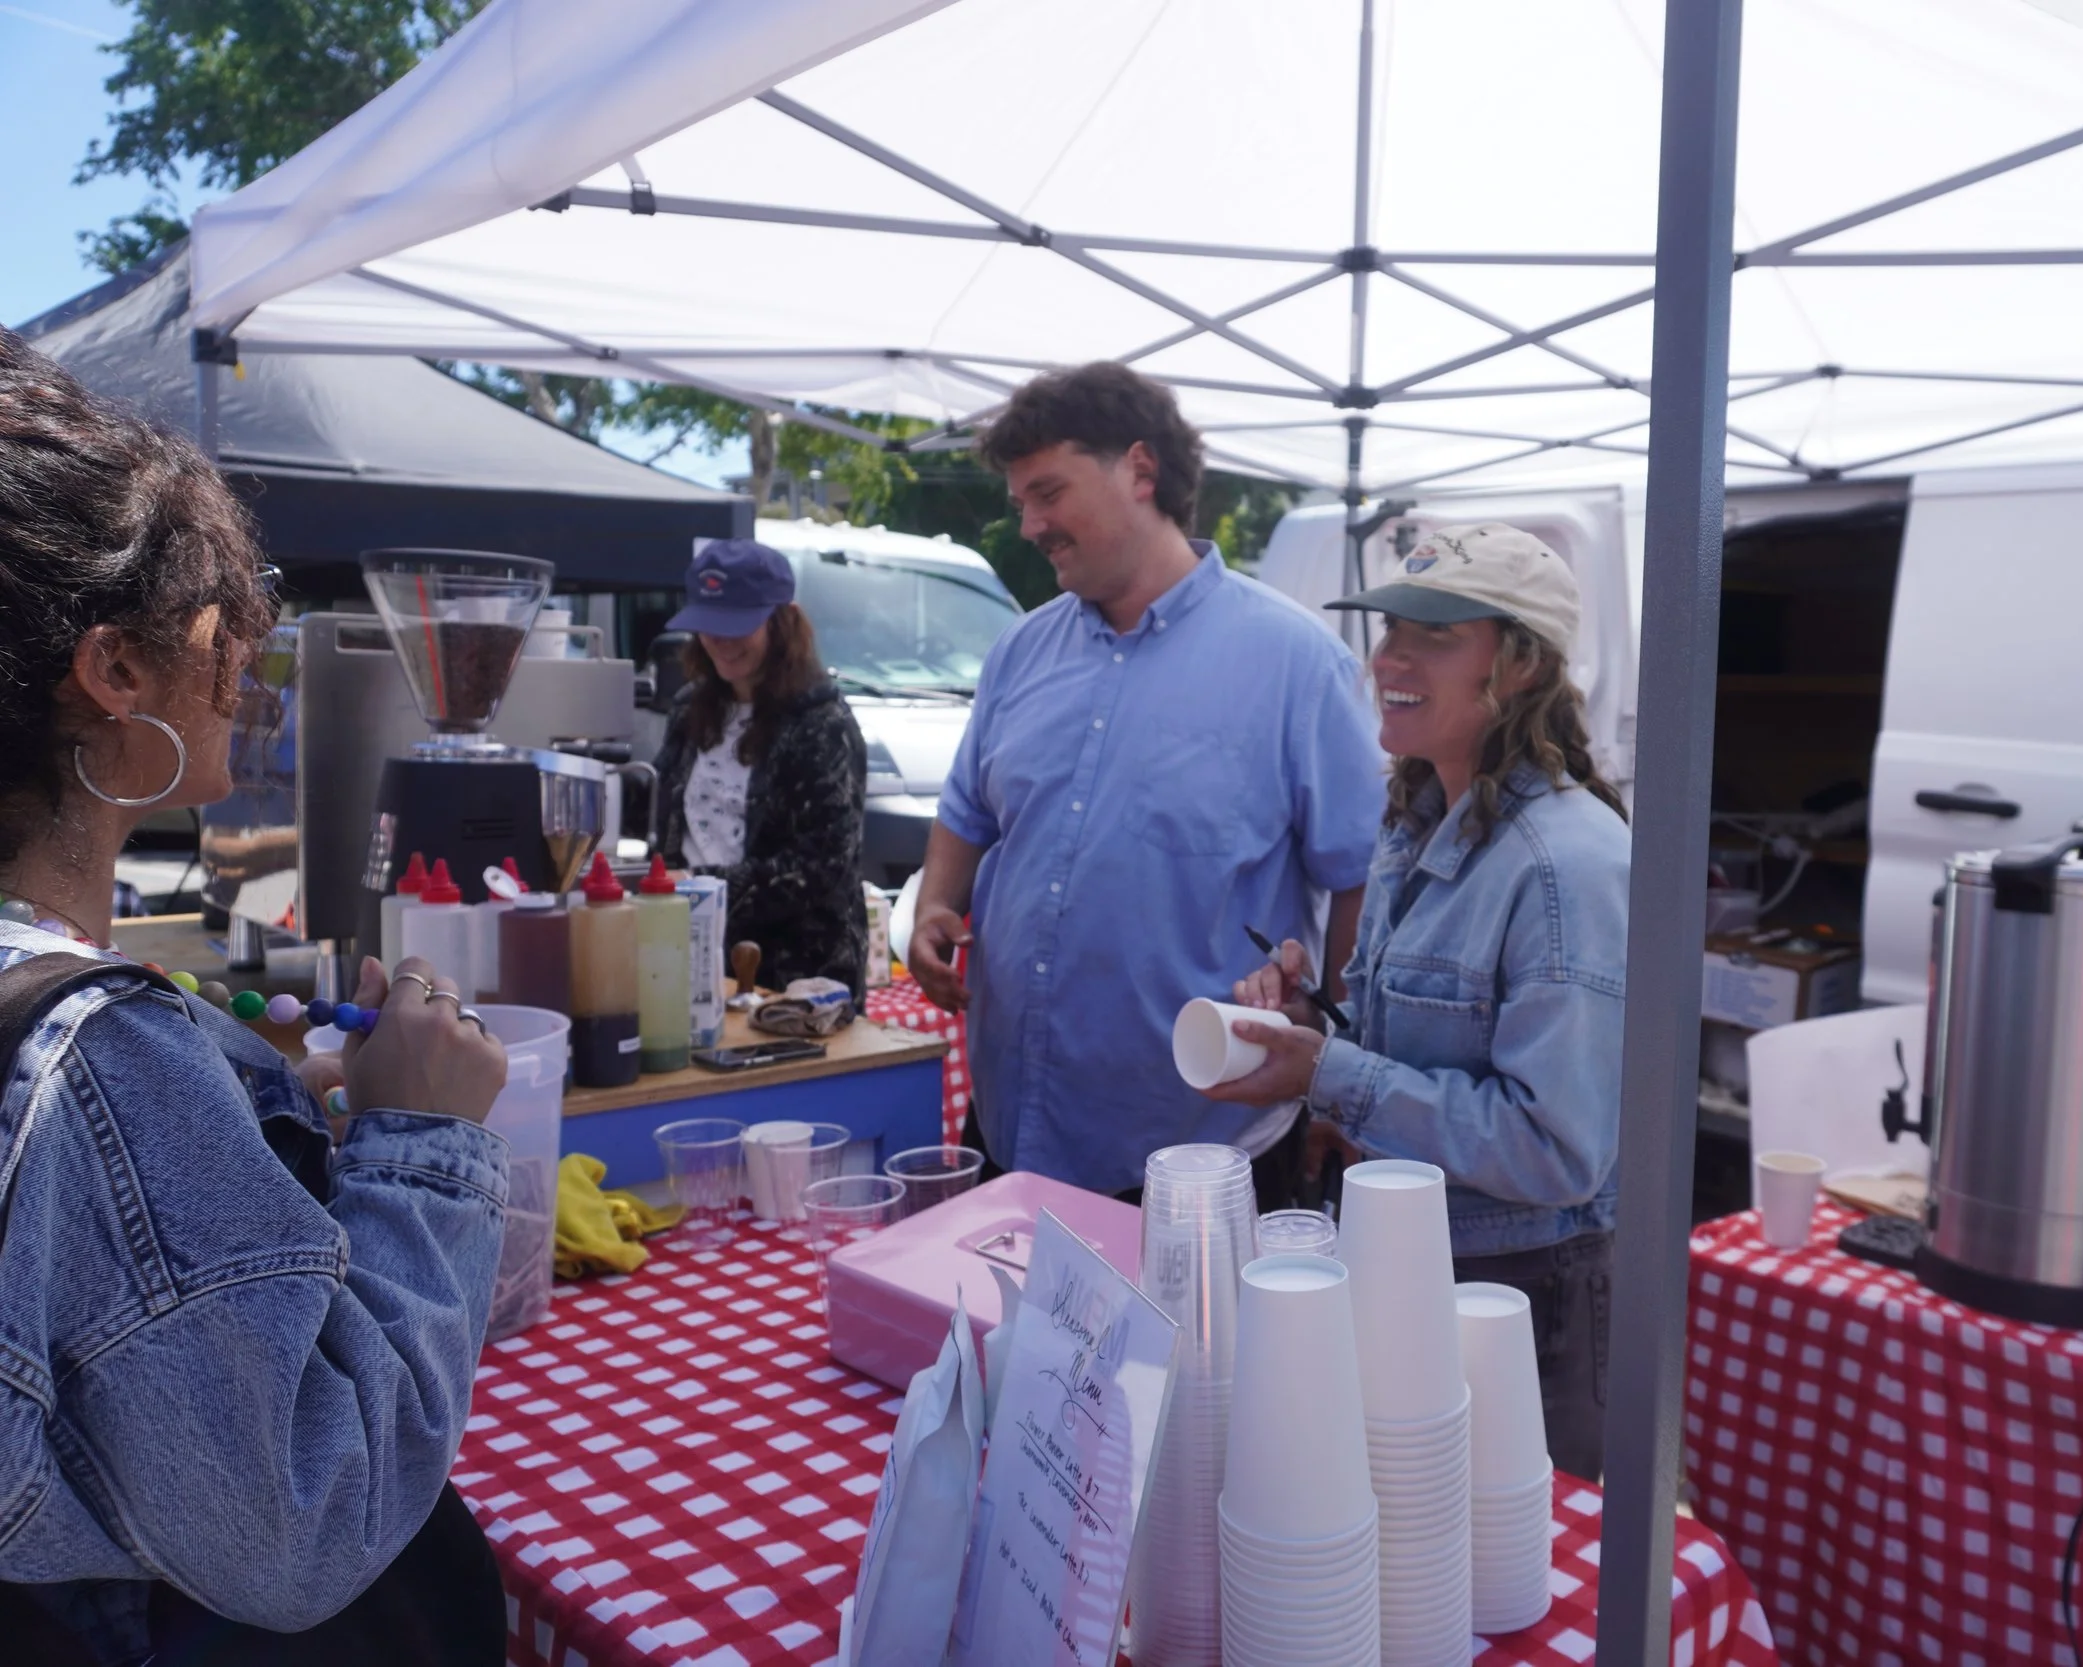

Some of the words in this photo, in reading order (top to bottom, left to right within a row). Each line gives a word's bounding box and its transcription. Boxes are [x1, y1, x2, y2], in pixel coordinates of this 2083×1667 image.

[1051, 1281, 1111, 1360] Seasonal
[1069, 1349, 1103, 1406] Menu
[1064, 1455, 1083, 1484] Latte
[1060, 1543, 1078, 1574] Latte
